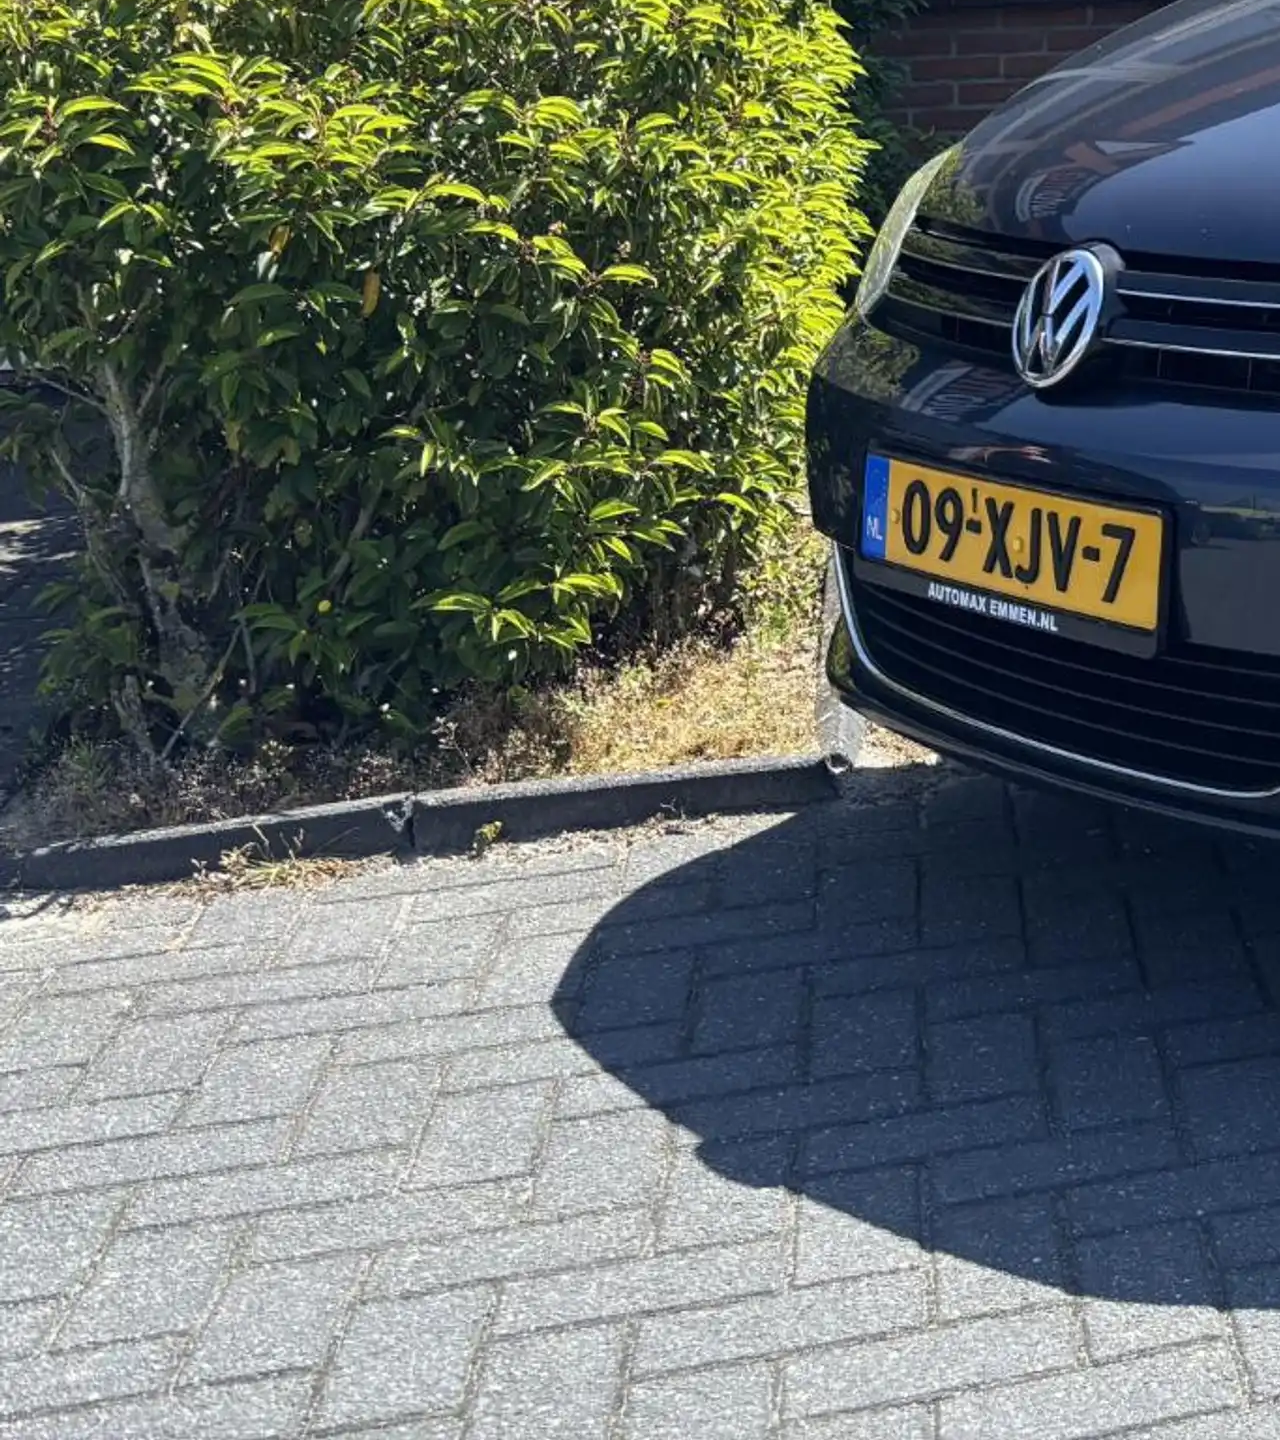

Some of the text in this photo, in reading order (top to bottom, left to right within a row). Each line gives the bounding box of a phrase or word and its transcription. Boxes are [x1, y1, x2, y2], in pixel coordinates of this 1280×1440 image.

[866, 515, 883, 541] NL
[902, 479, 1136, 604] 09-XJV-7
[927, 582, 1058, 632] AUTOMAX EMMEN.NL
